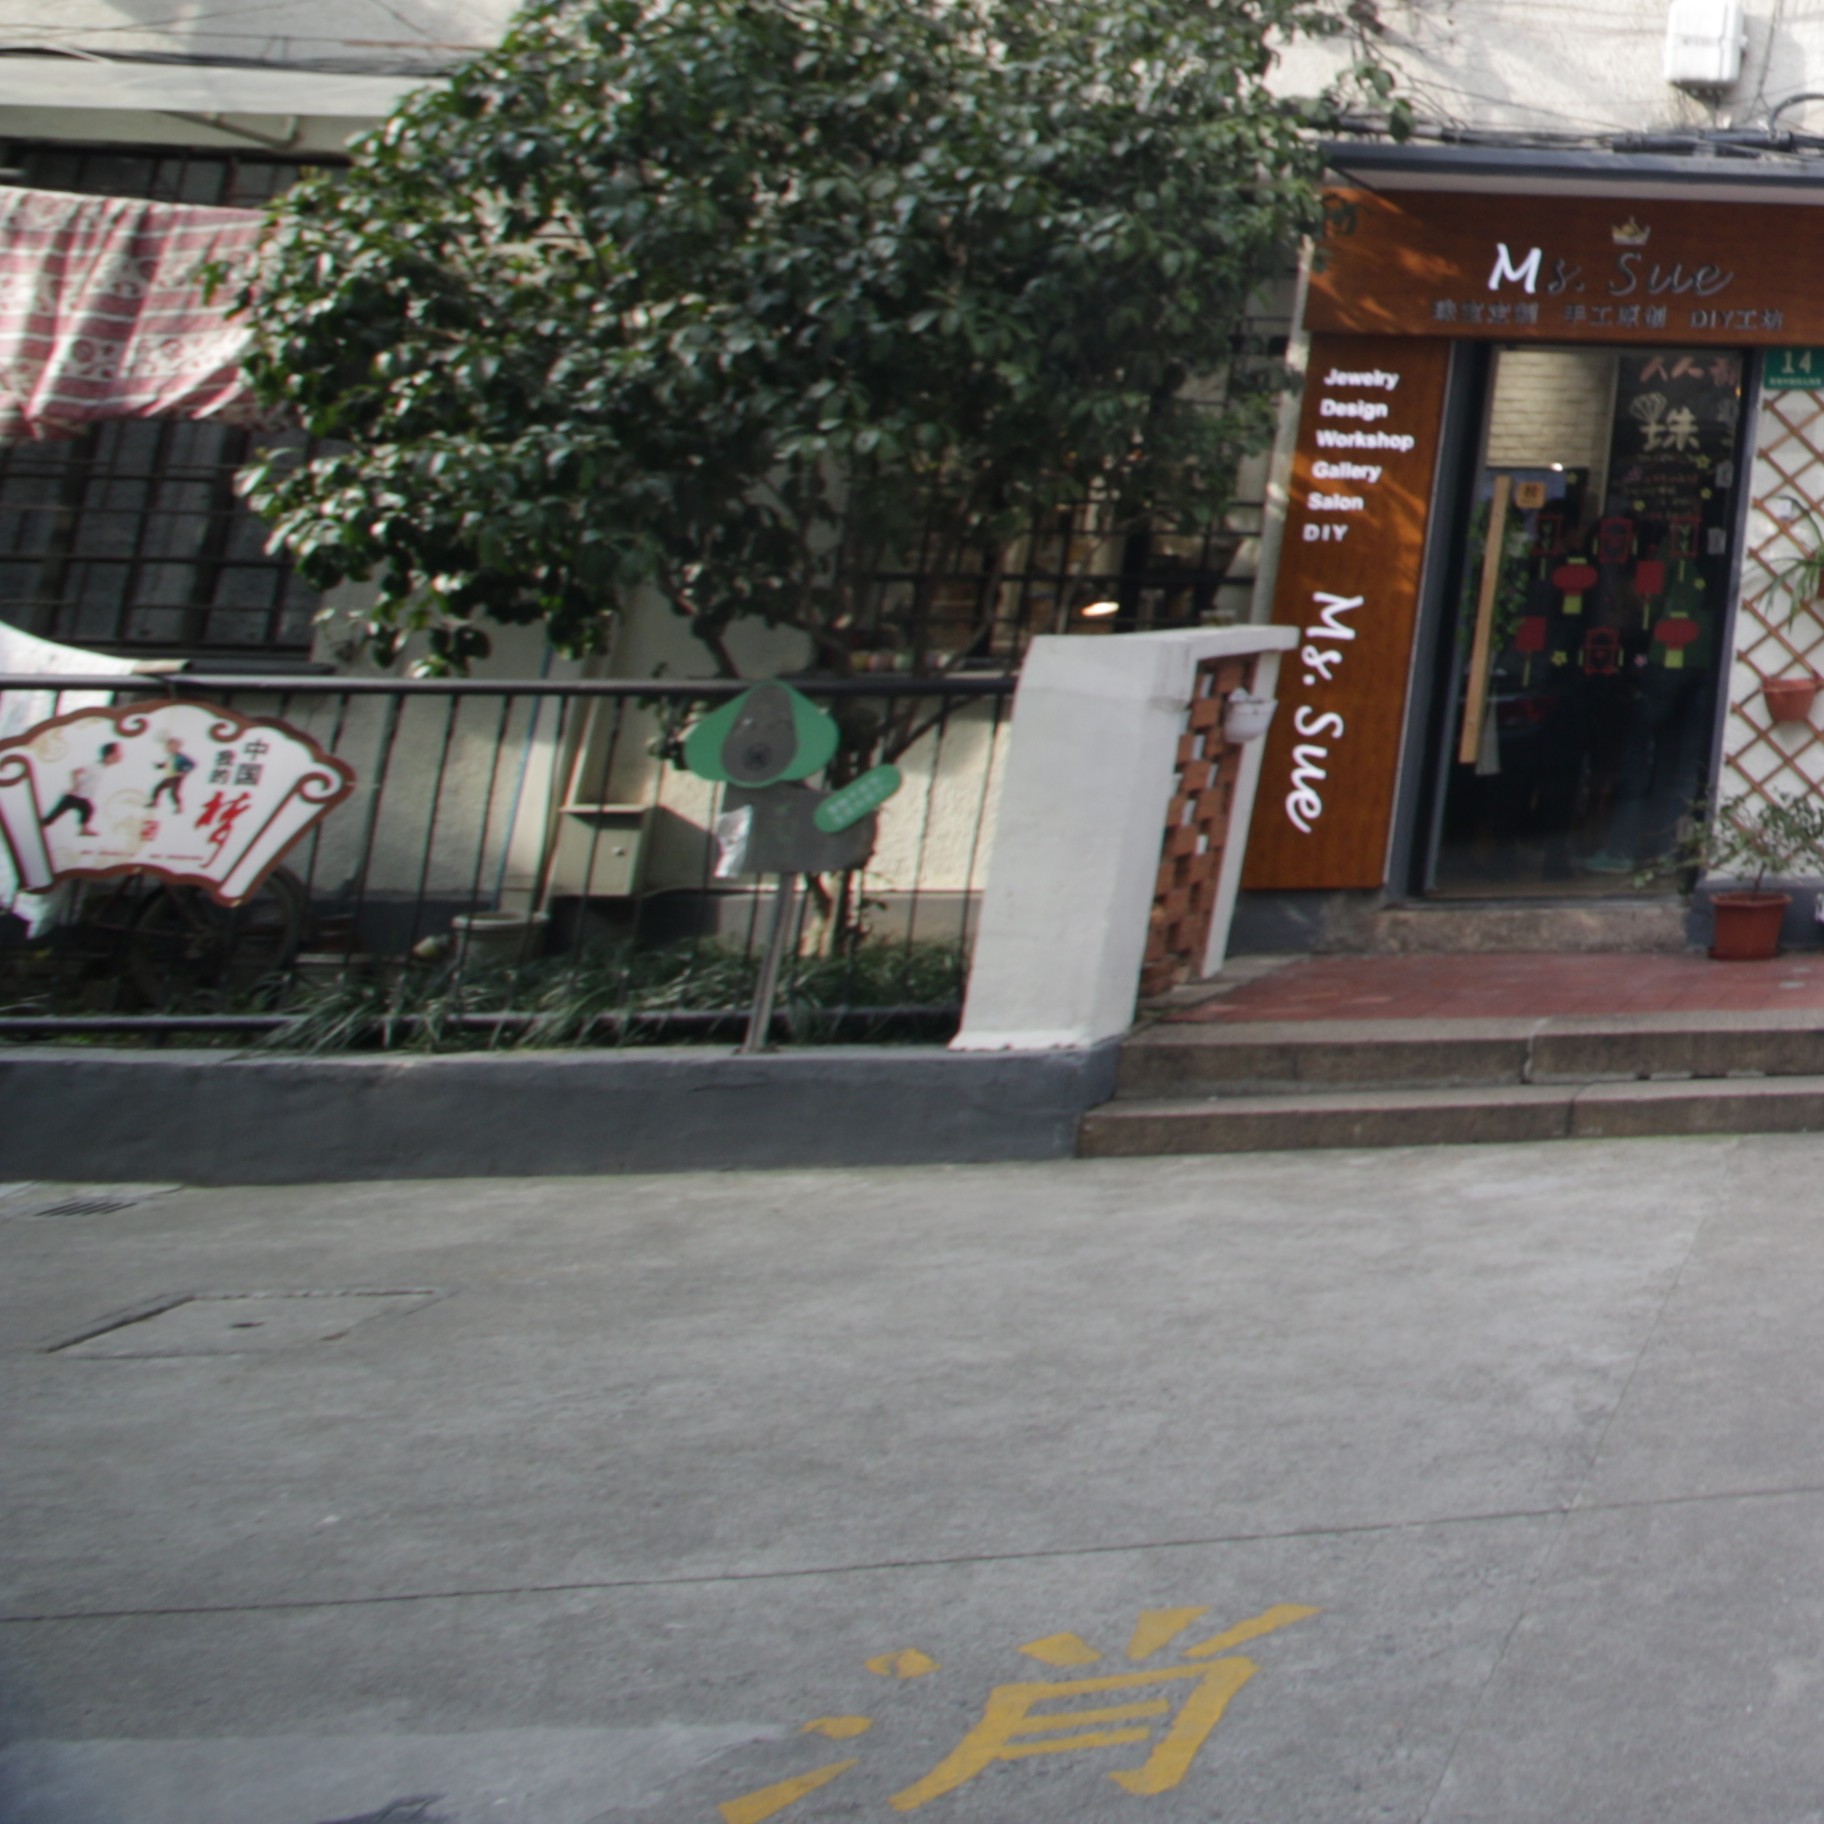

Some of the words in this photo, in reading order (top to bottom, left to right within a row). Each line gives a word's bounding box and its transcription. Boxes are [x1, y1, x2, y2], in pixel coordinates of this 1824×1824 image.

[1487, 242, 1586, 295] Ms.
[1609, 251, 1734, 296] Sue
[1781, 350, 1812, 374] 14
[1323, 368, 1399, 391] Jewelry
[1319, 398, 1388, 422] Design
[1316, 429, 1415, 452] Workshop
[1311, 459, 1382, 483] Gallery
[1307, 492, 1365, 511] Salon
[1301, 591, 1364, 686] Ms.
[233, 740, 270, 786] 中国
[1285, 704, 1344, 834] Sue
